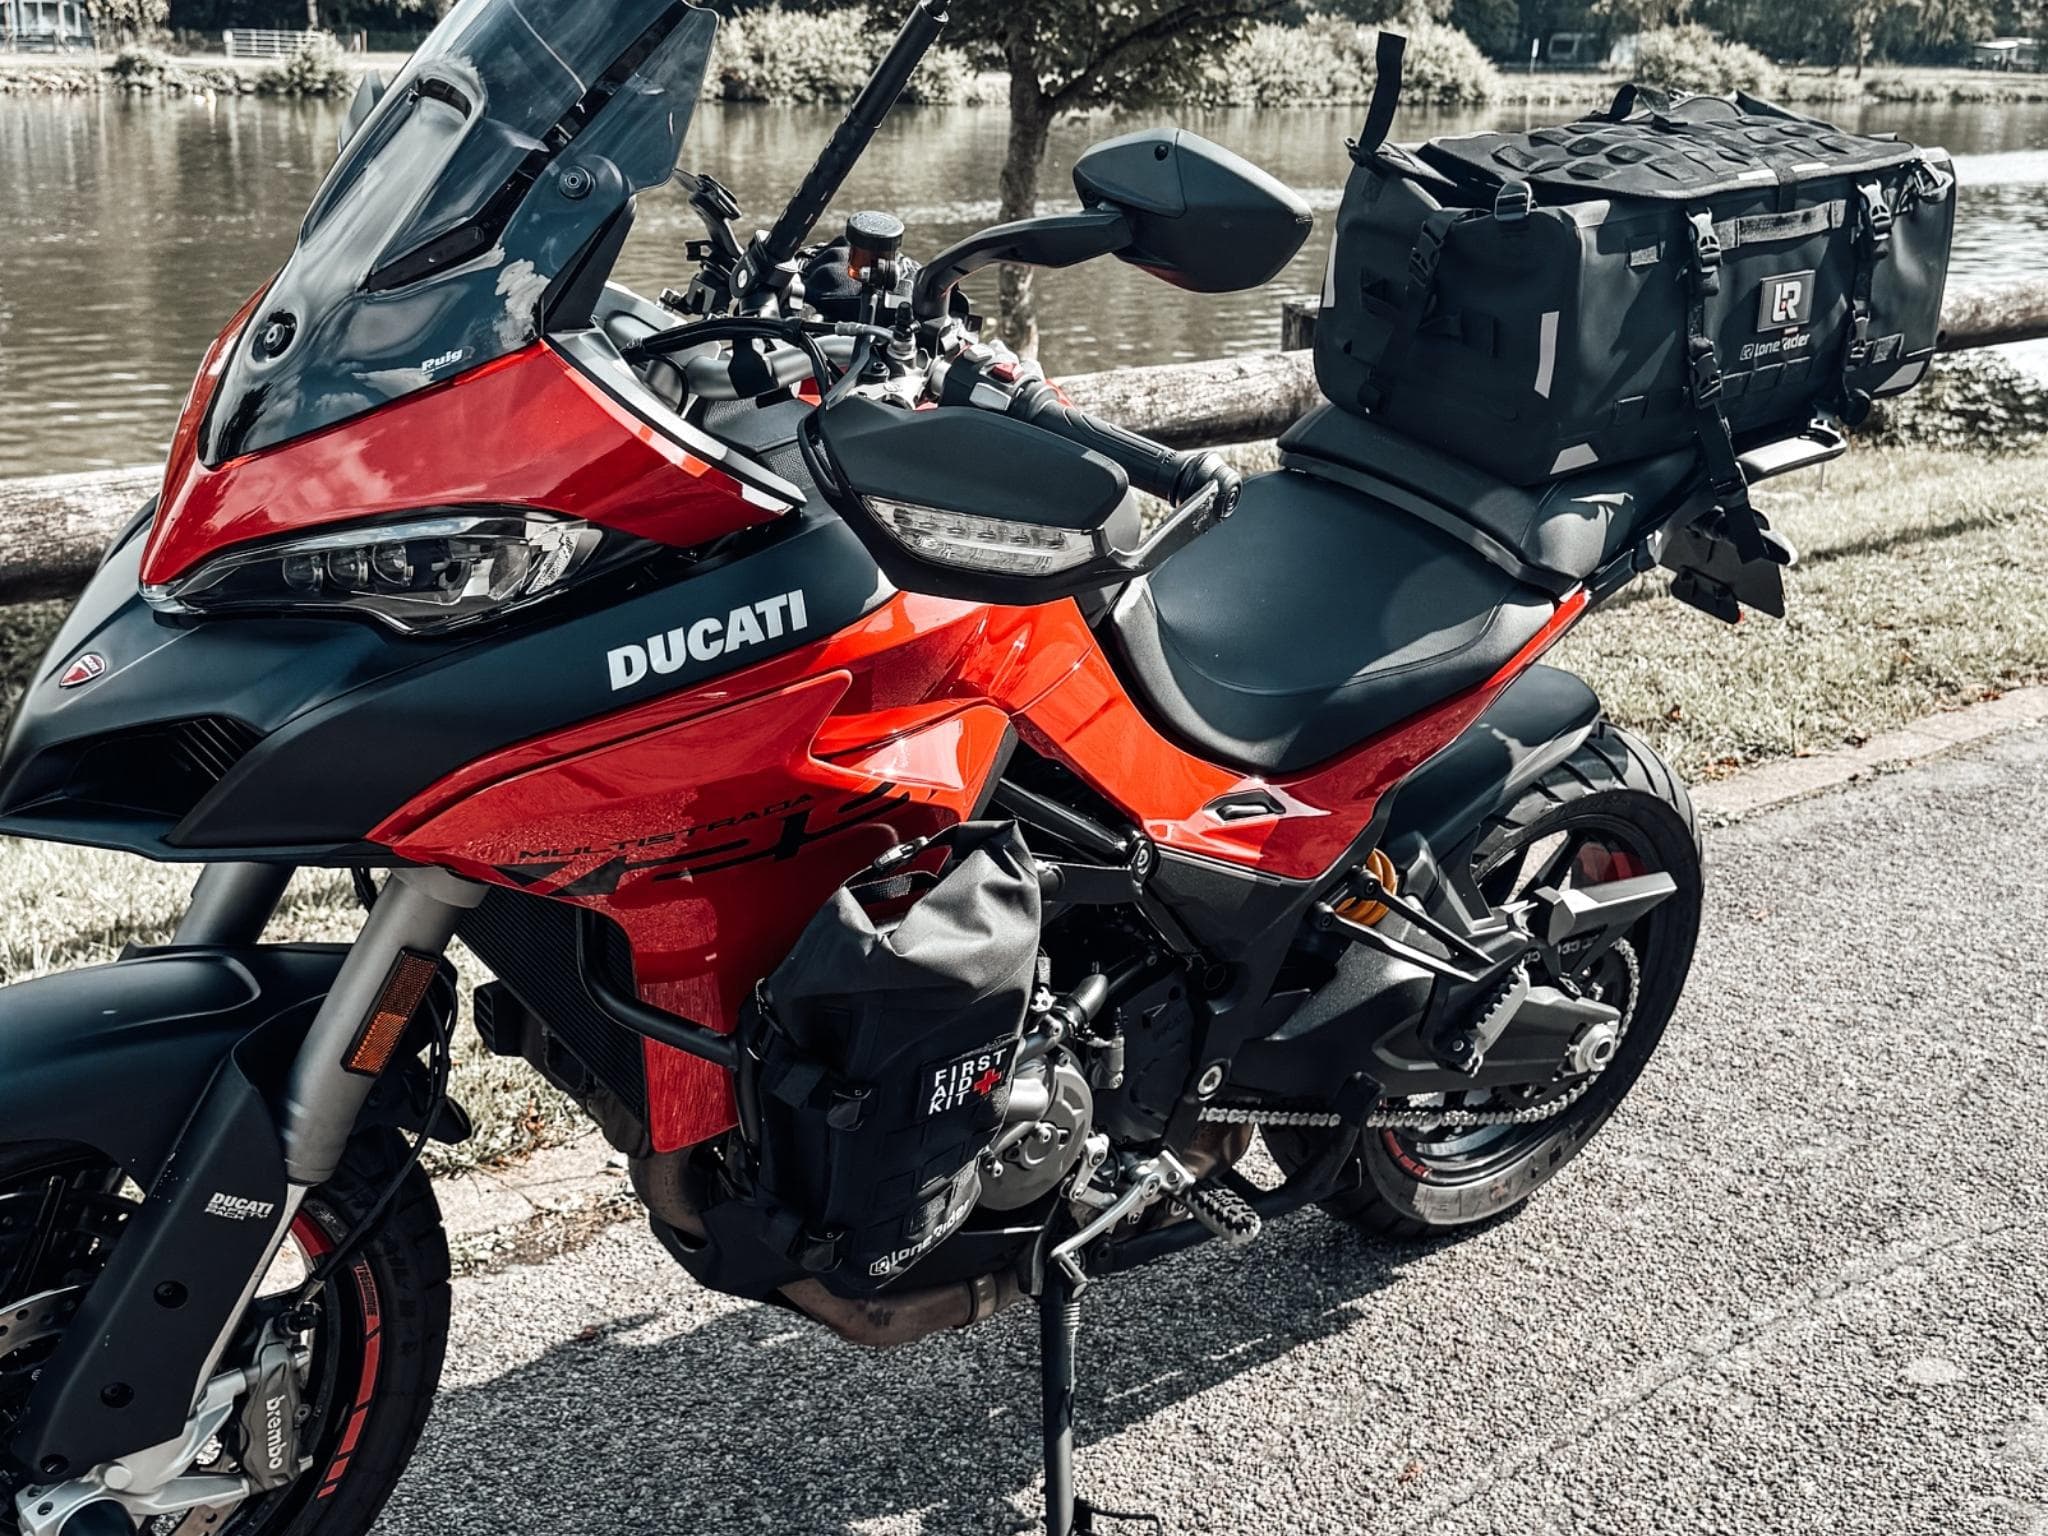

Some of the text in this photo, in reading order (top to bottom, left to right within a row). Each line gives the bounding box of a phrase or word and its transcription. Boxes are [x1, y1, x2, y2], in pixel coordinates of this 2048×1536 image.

[1772, 281, 1802, 322] LR
[421, 349, 463, 371] Puig
[607, 588, 808, 692] DUCATI
[519, 793, 813, 859] MULTISTRADA
[934, 1048, 1008, 1088] FIRST
[928, 1089, 970, 1116] KIT
[931, 1076, 973, 1102] AID
[210, 1191, 275, 1215] DUCATI
[891, 1235, 934, 1266] Lone
[266, 1394, 288, 1470] brembo
